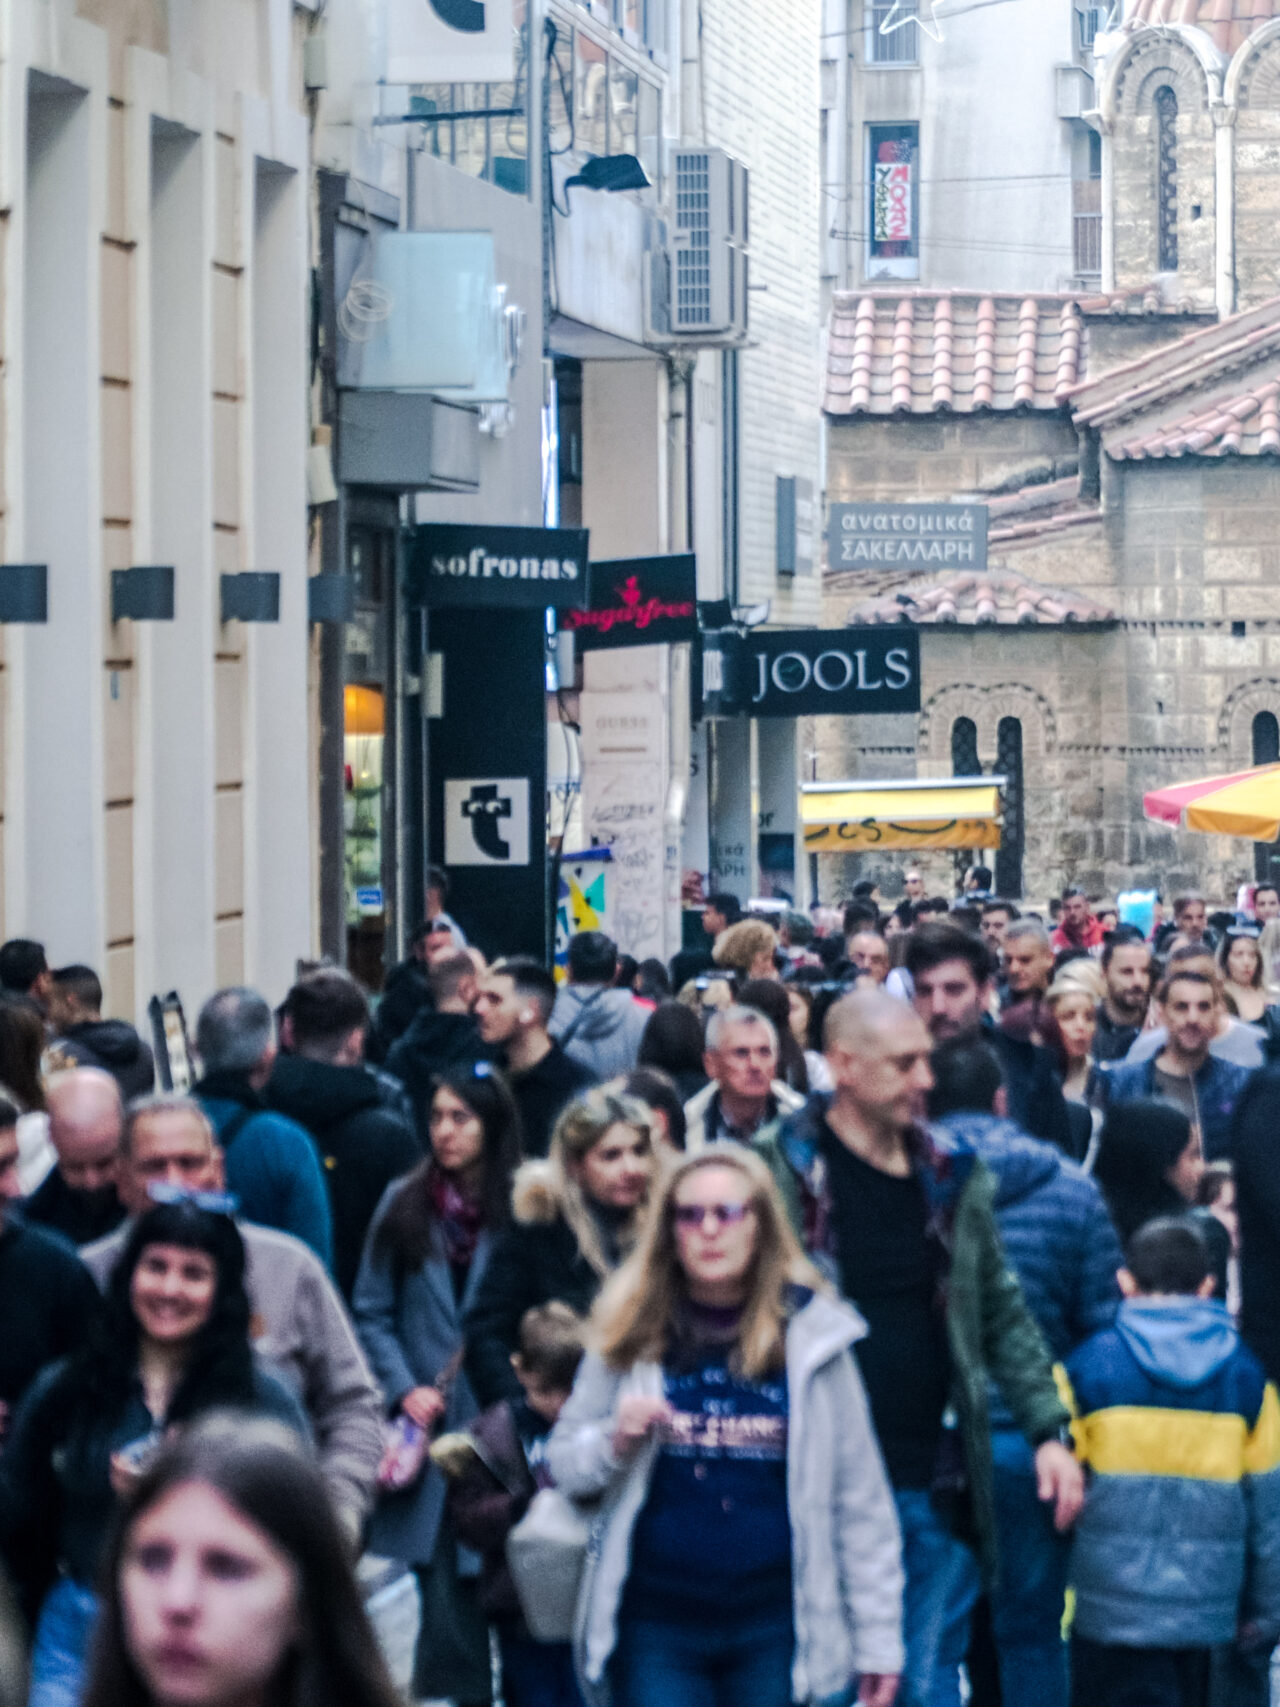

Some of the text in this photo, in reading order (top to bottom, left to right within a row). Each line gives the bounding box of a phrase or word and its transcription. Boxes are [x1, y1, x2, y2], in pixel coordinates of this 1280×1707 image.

[841, 509, 973, 534] ανατομικά
[432, 548, 578, 580] sofronas
[841, 541, 973, 562] ΣΑΚΕΛΛΑΡΗ
[752, 649, 912, 702] JOOLS
